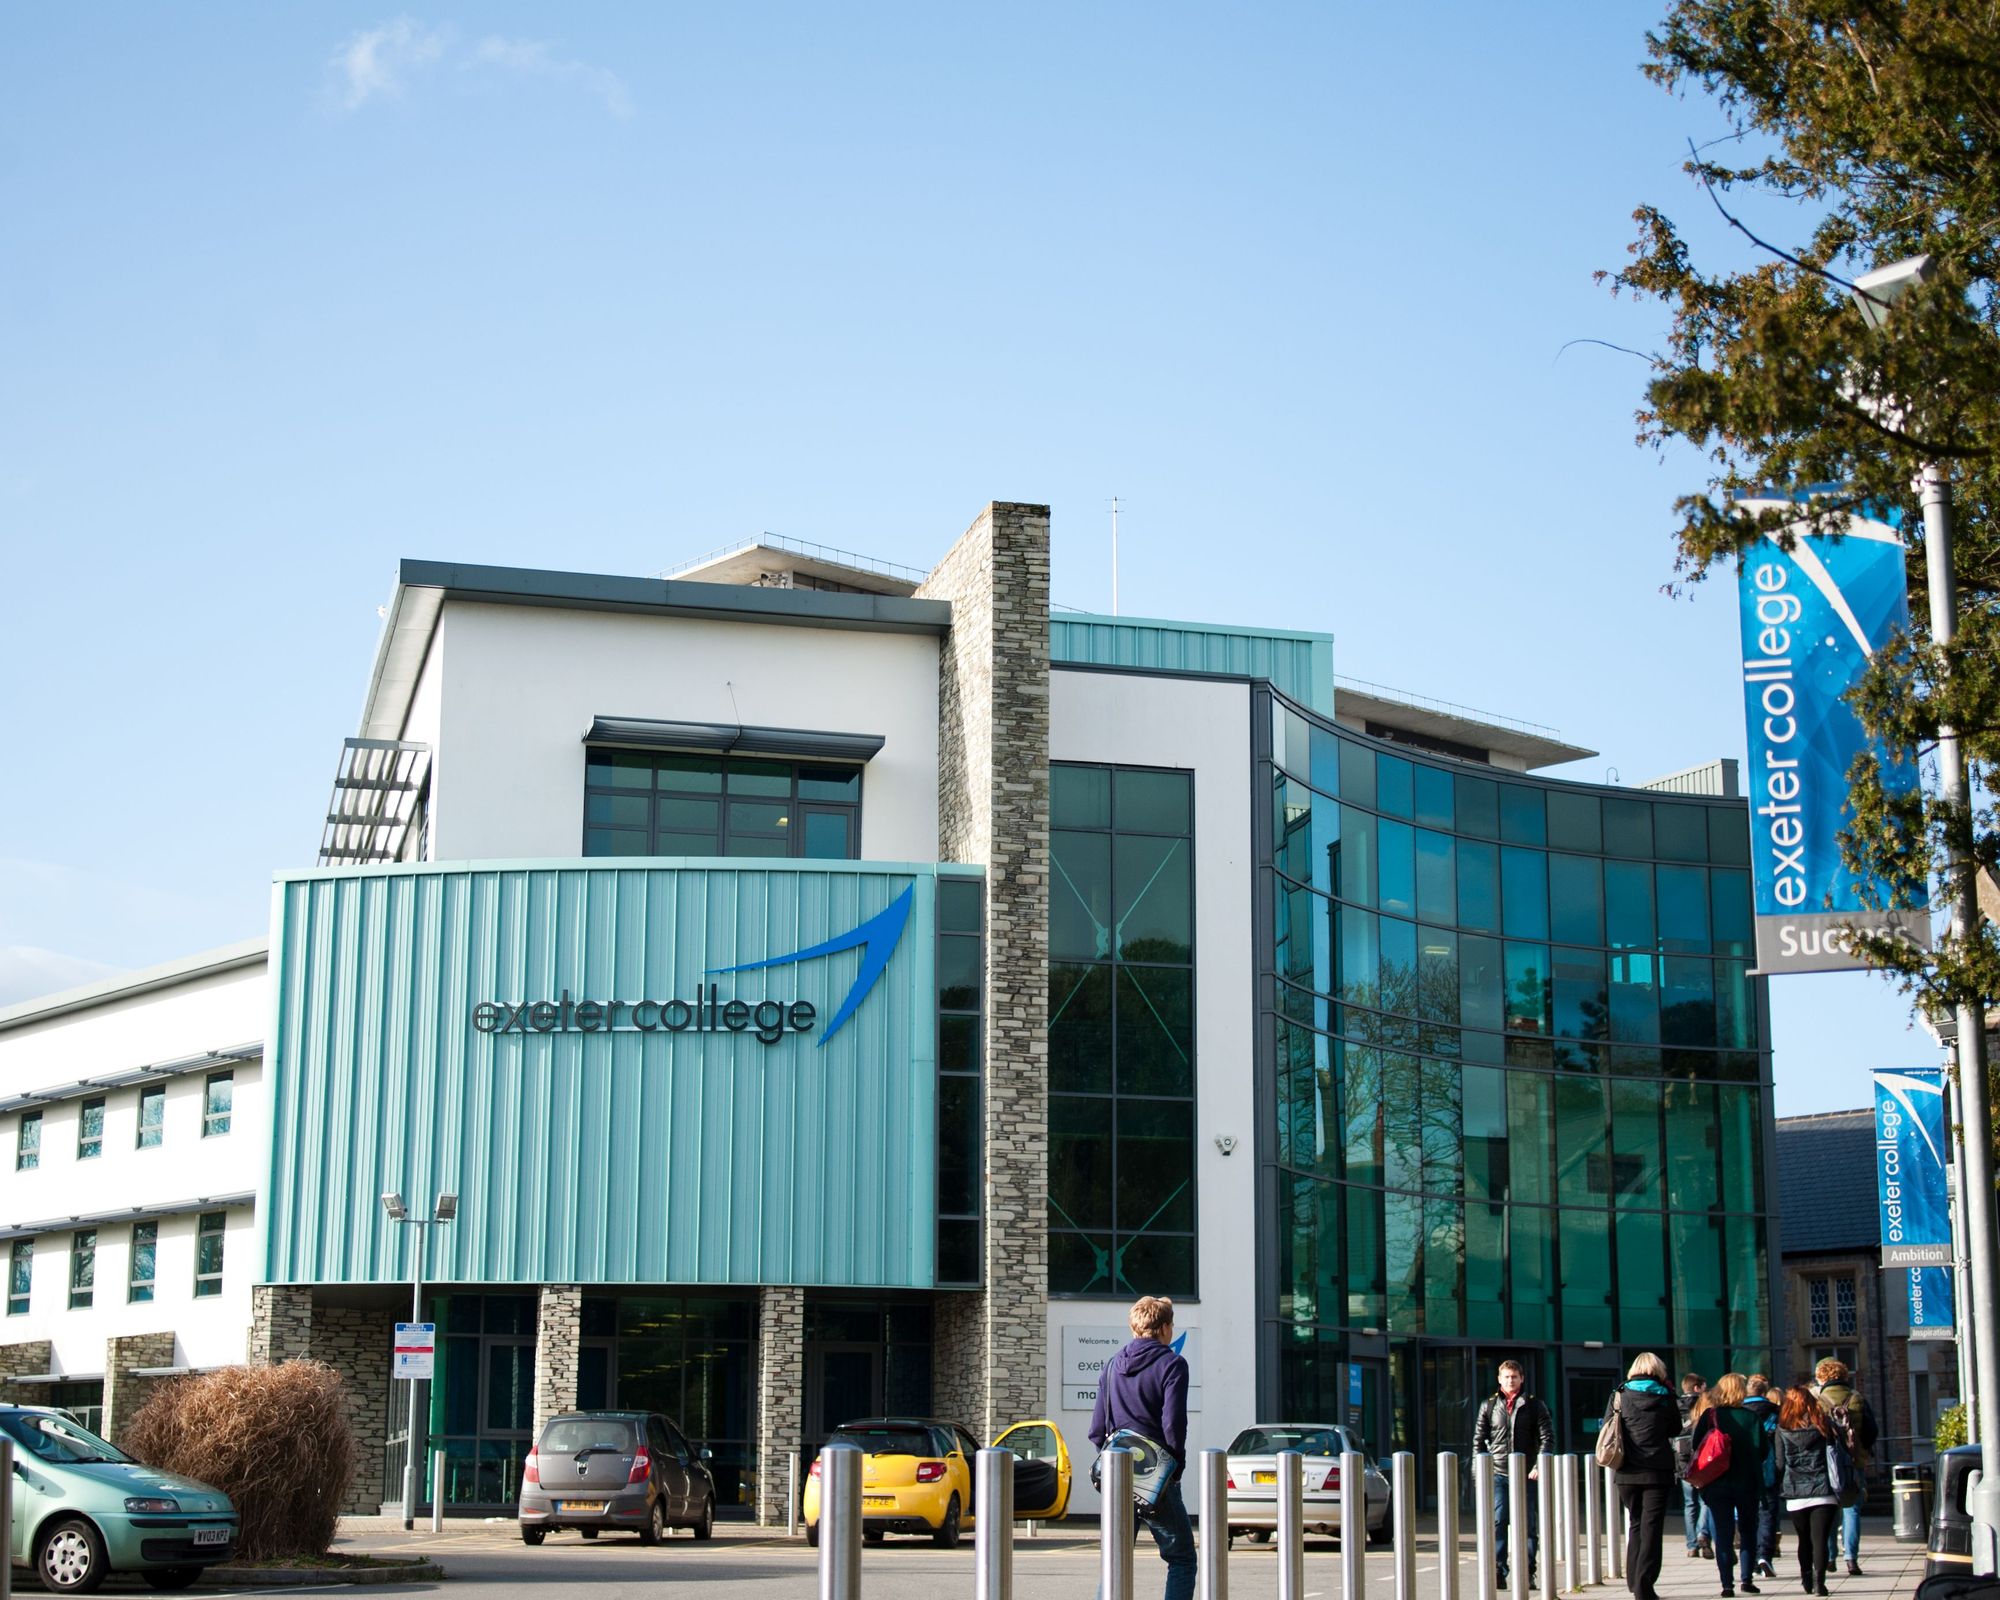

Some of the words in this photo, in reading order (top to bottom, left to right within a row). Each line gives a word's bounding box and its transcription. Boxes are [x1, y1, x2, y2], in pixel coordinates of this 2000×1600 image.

[1744, 563, 1801, 743] college
[1757, 749, 1806, 906] exeter
[472, 989, 625, 1033] exeter
[631, 983, 816, 1045] college
[1878, 1100, 1902, 1176] college
[1883, 1179, 1903, 1242] exeter
[1890, 1249, 1944, 1262] Ambition
[1910, 1284, 1924, 1325] exeter
[1078, 1337, 1110, 1345] Welcome
[1912, 1329, 1952, 1338] Inspiration
[1077, 1360, 1105, 1371] exet
[1077, 1390, 1097, 1400] ma
